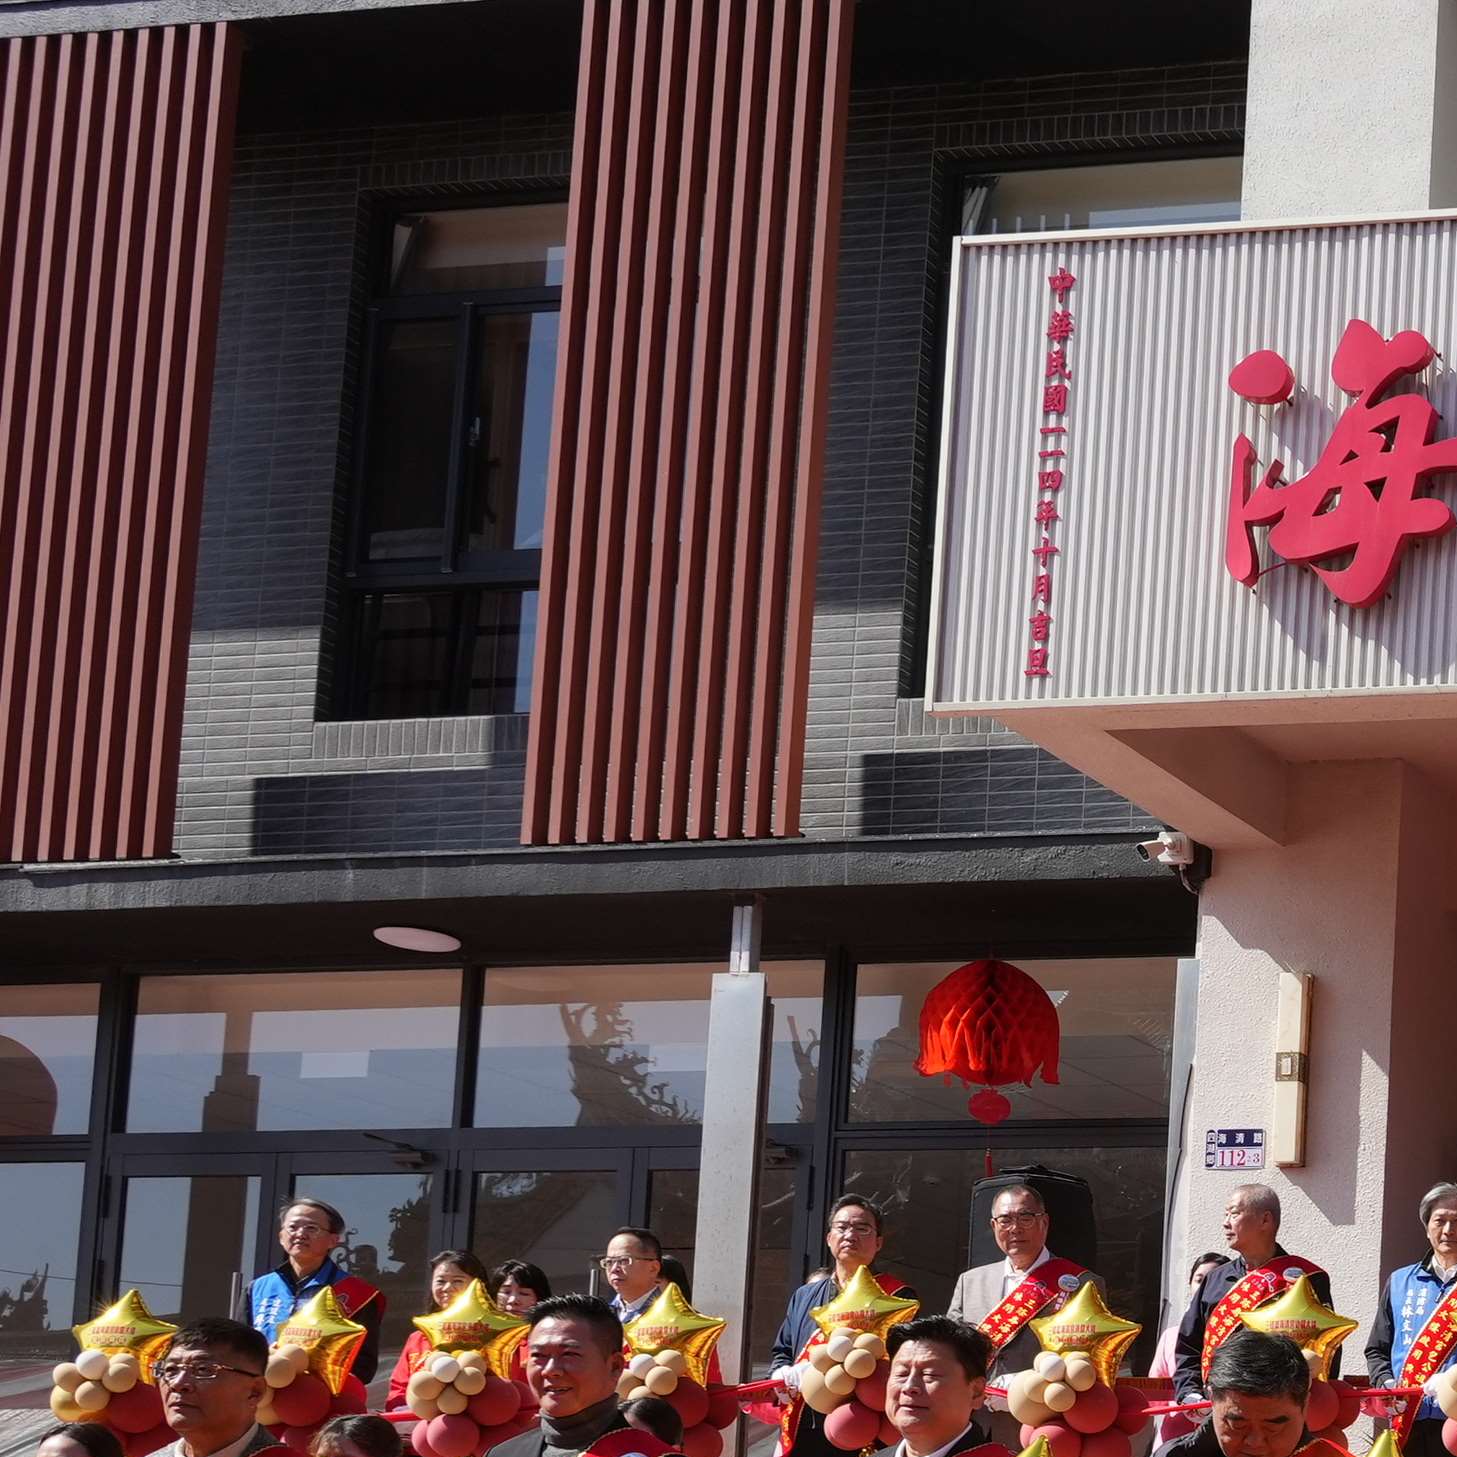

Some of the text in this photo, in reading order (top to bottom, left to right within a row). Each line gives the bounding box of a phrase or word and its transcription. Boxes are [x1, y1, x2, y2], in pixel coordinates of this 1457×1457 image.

[1024, 267, 1075, 677] 中華民國一一四年十月吉旦
